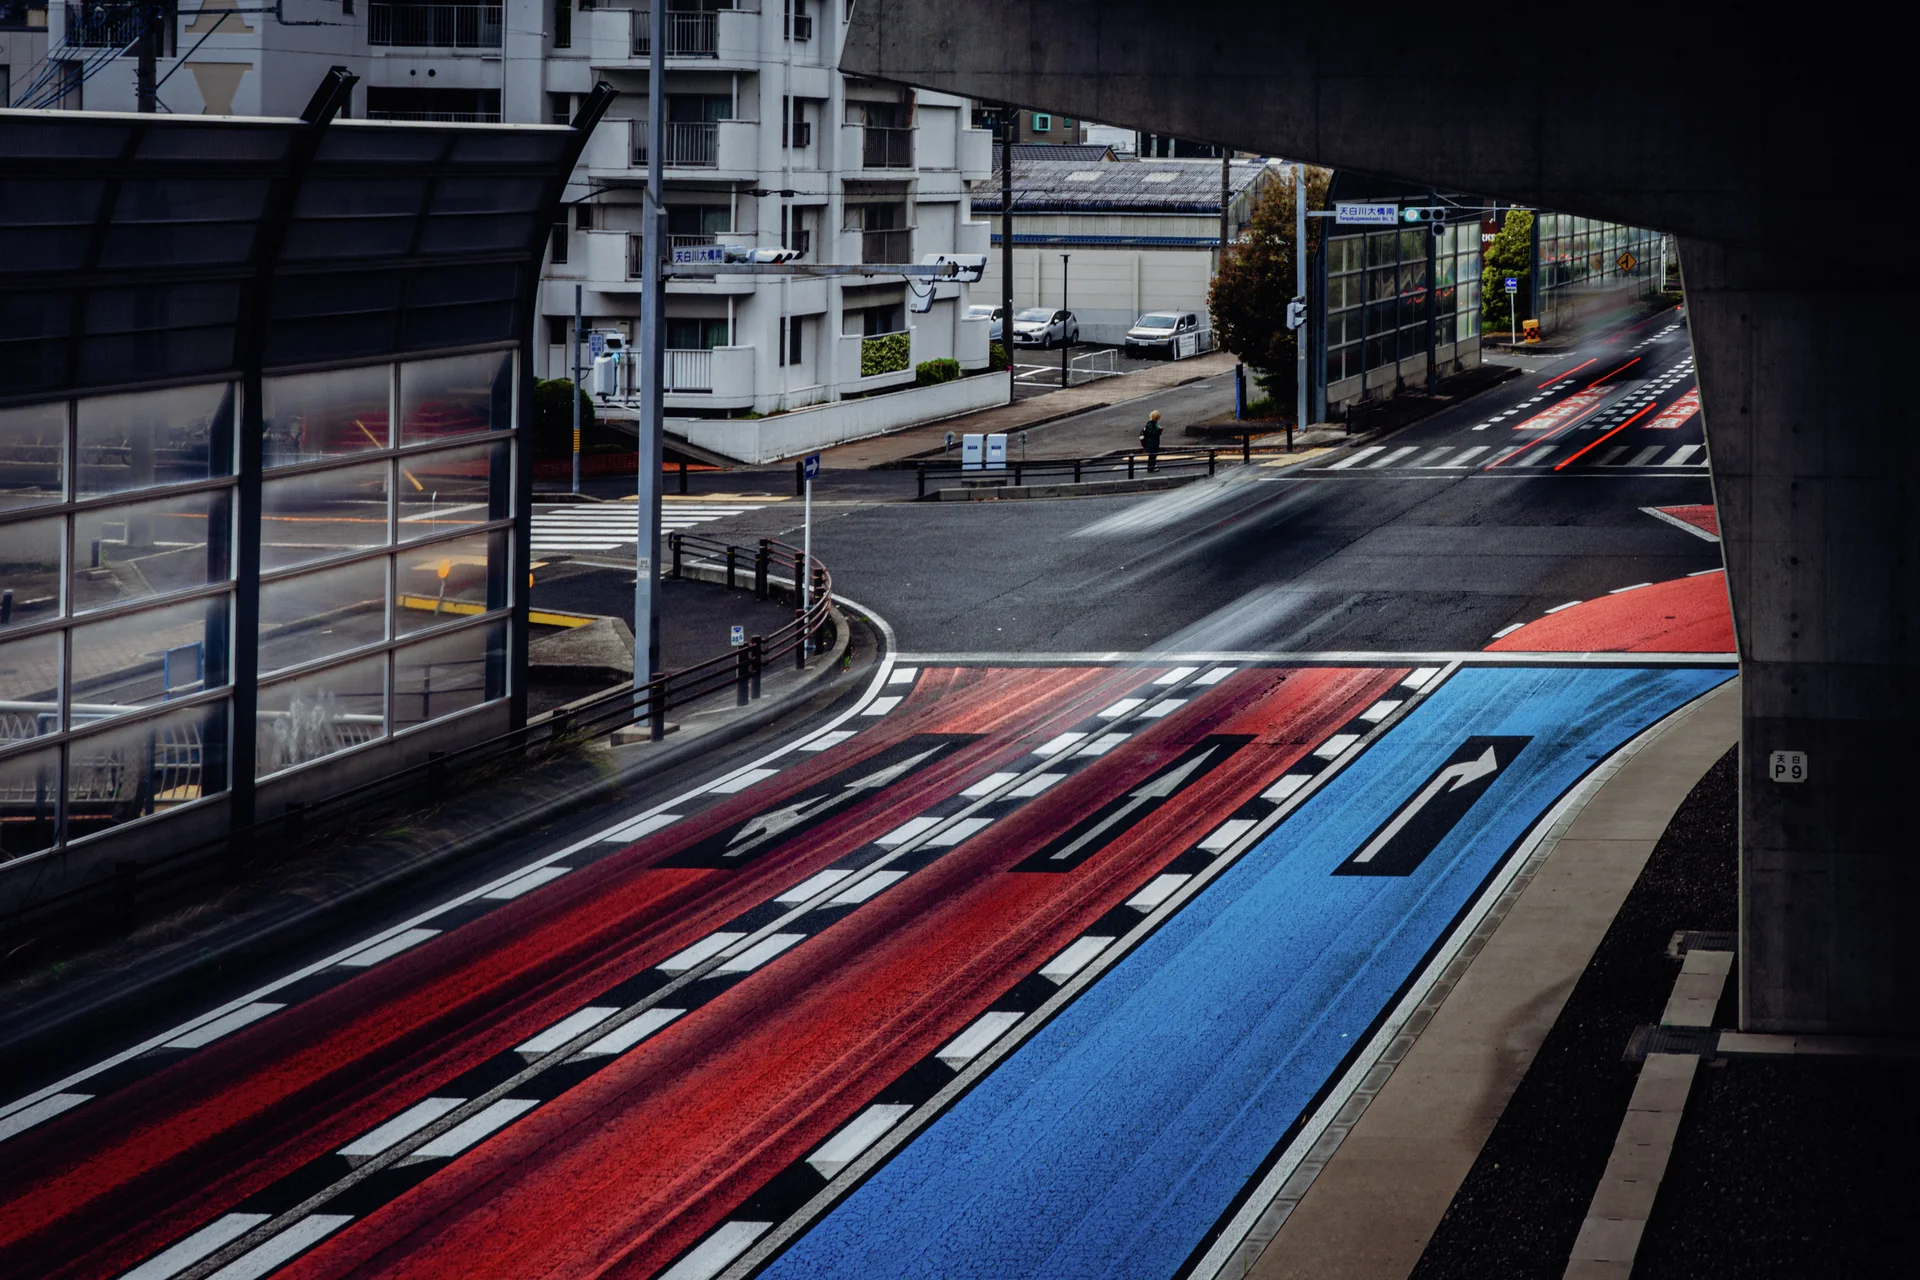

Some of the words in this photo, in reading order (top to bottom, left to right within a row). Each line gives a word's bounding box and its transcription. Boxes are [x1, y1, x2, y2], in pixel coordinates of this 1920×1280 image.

[1340, 207, 1395, 216] 天白川大橋南
[675, 249, 723, 263] 天白川大橋南
[1645, 390, 1699, 429] 突注意
[1777, 754, 1800, 764] 天白
